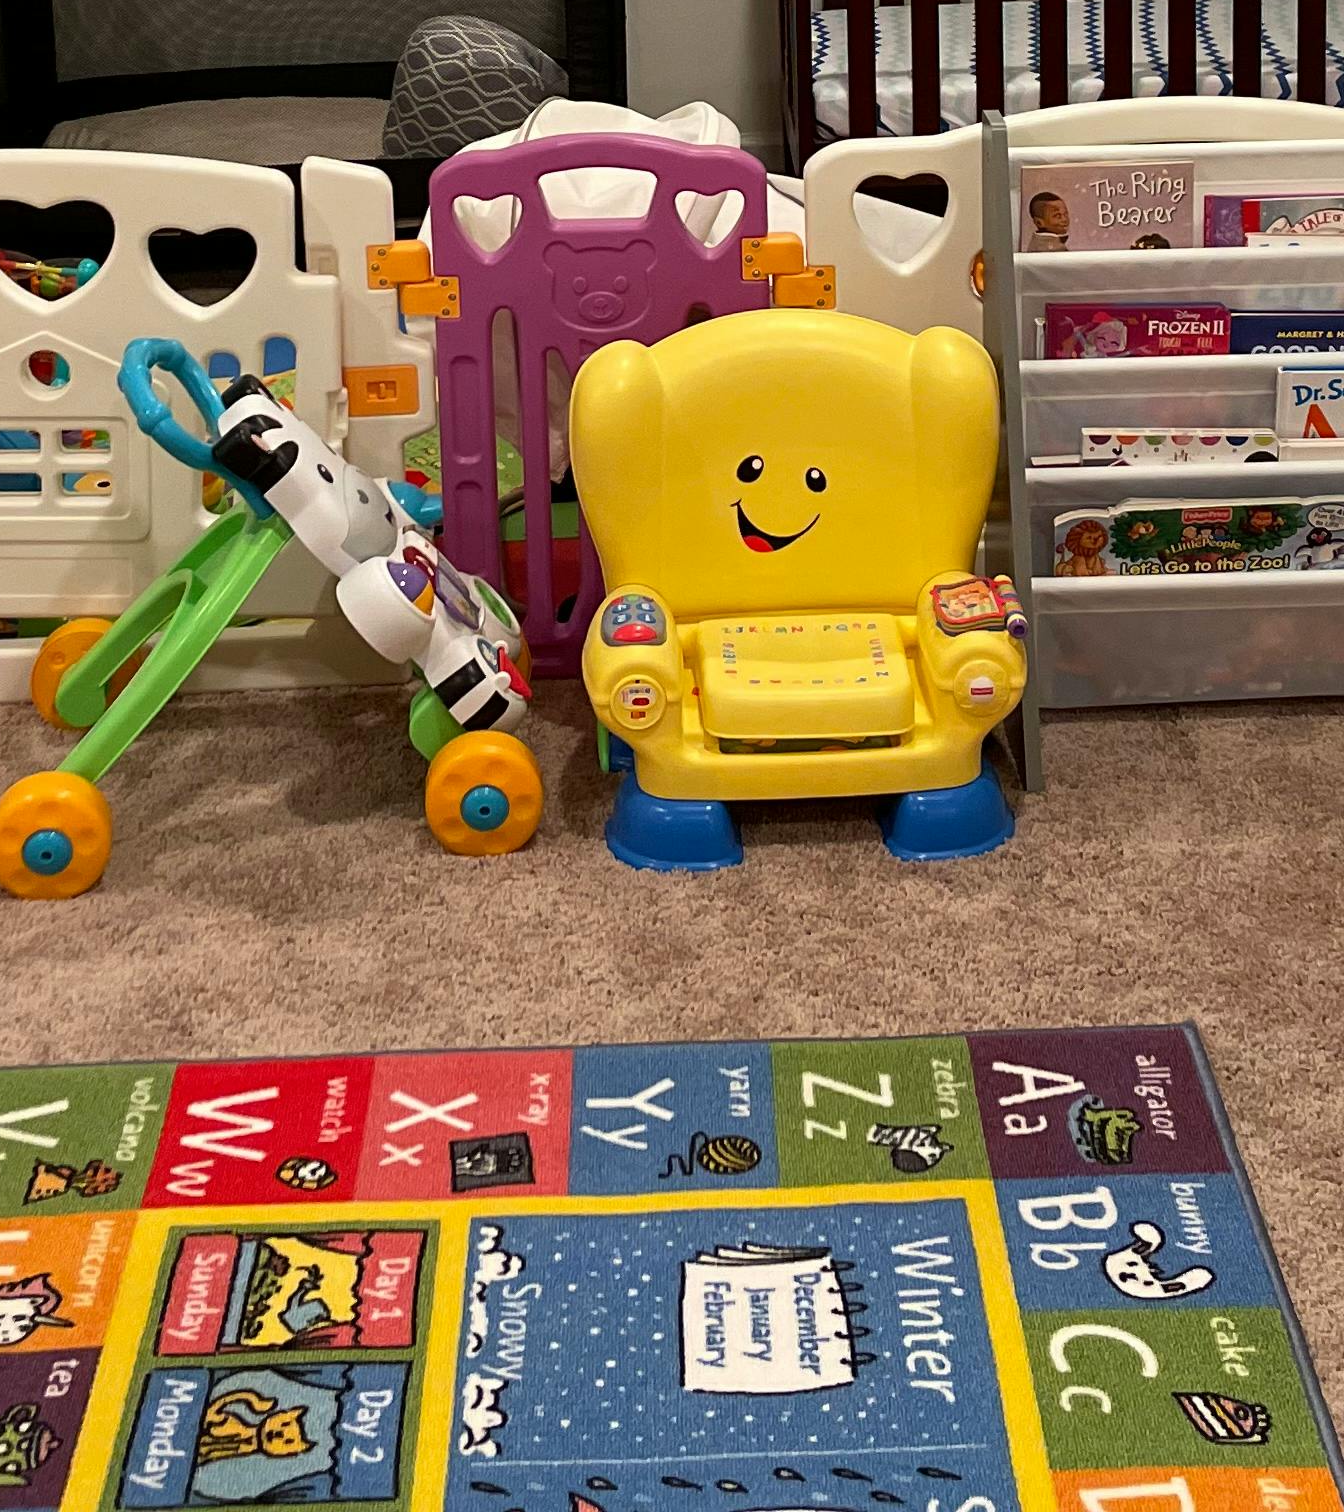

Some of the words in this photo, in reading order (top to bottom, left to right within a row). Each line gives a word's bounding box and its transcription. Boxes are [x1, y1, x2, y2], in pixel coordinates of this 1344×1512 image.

[1089, 178, 1128, 199] The
[1131, 170, 1188, 204] Ring
[1098, 200, 1178, 228] Bearer
[1299, 212, 1331, 232] TALE
[1147, 319, 1211, 336] FROZEN
[1212, 319, 1225, 336] II
[1276, 330, 1324, 338] MARGRET
[1292, 384, 1326, 407] Dr.
[1121, 561, 1160, 575] Let's
[1164, 559, 1190, 574] Go
[1194, 558, 1212, 573] to
[1216, 556, 1245, 571] the
[1249, 554, 1290, 570] Zoo!
[317, 1076, 353, 1143] watch
[517, 1072, 552, 1126] x-ray
[718, 1065, 752, 1118] yarn
[932, 1057, 968, 1120] zebra
[1134, 1054, 1178, 1141] alligator
[115, 1076, 160, 1162] volcano
[1170, 1181, 1213, 1255] bunny
[73, 1219, 121, 1308] unicorn
[363, 1255, 412, 1302] Day
[167, 1251, 228, 1342] Sunday
[371, 1306, 404, 1322] 1
[695, 1280, 737, 1370] February
[742, 1287, 776, 1364] January
[793, 1271, 831, 1377] December
[891, 1235, 964, 1404] Winter
[482, 1282, 543, 1383] Snowy
[1210, 1315, 1258, 1378] cake
[44, 1357, 80, 1399] tea
[128, 1378, 198, 1489] Monday
[341, 1388, 394, 1438] Day
[350, 1447, 385, 1465] 2
